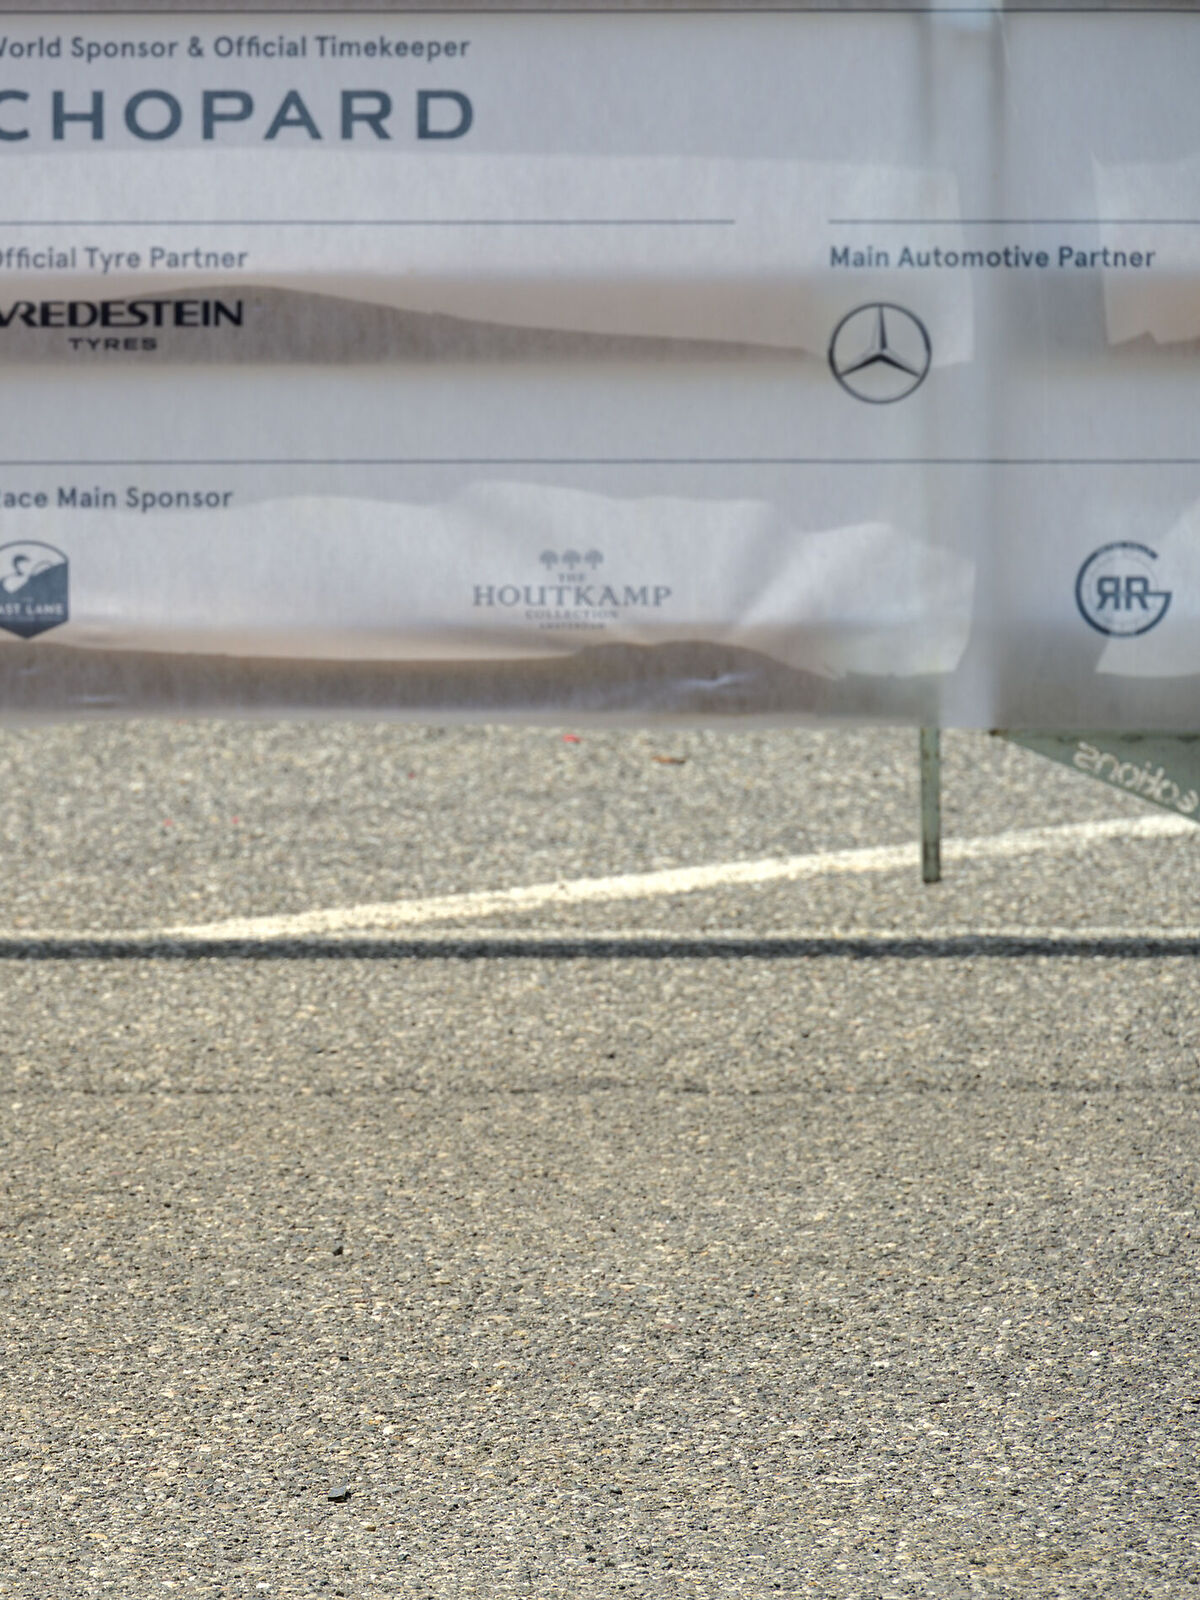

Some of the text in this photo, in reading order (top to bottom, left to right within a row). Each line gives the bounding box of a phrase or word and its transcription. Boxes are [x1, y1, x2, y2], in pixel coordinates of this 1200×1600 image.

[70, 36, 179, 62] Sponsor
[187, 37, 204, 58] &
[213, 35, 307, 58] Official
[315, 35, 471, 61] Timekeeper
[84, 248, 141, 274] Tyre
[150, 247, 248, 269] Partner
[830, 244, 1156, 268] Main Automotive Partner
[68, 337, 158, 351] TYRES
[58, 486, 117, 508] Main
[125, 487, 233, 512] Sponsor
[472, 584, 673, 608] HOUTKAMP
[25, 603, 65, 616] LANE
[525, 609, 620, 621] COLLECTION
